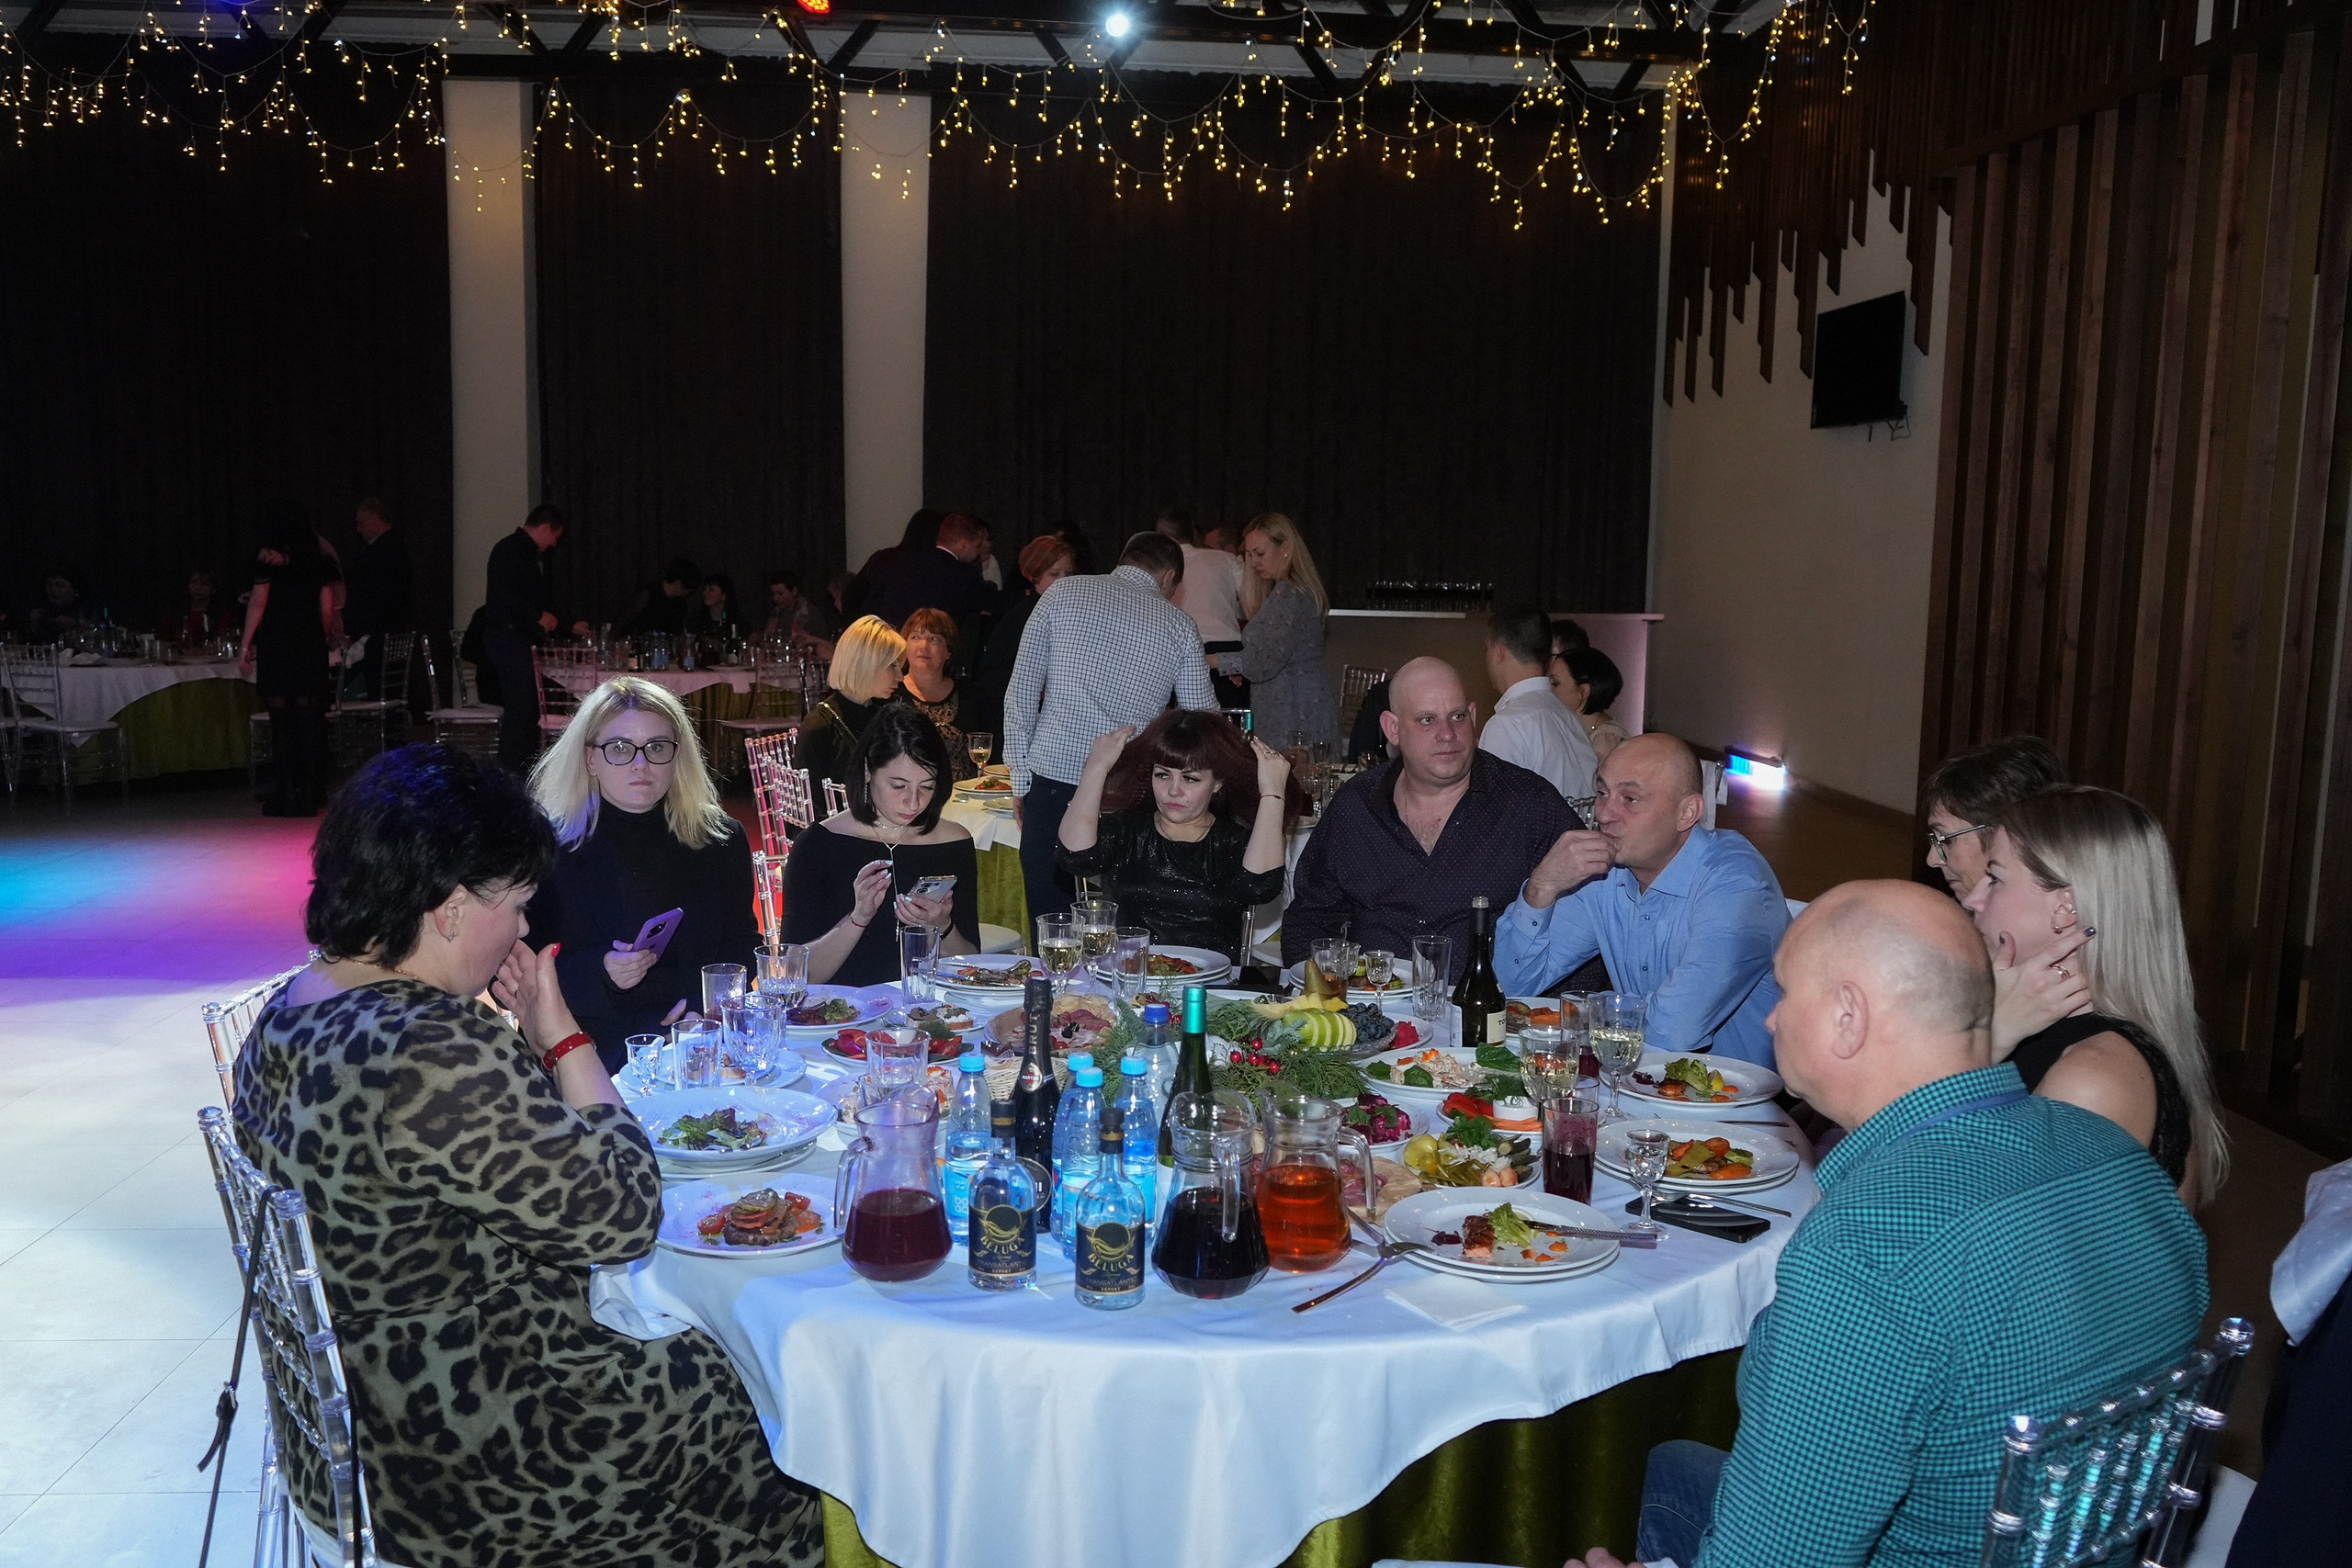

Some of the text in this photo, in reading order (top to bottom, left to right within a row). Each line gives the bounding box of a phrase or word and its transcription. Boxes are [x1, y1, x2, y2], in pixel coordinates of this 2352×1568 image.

[1028, 1012, 1038, 1055] BRUT
[979, 1235, 1025, 1255] BELUGA
[1087, 1252, 1135, 1272] BELUGA
